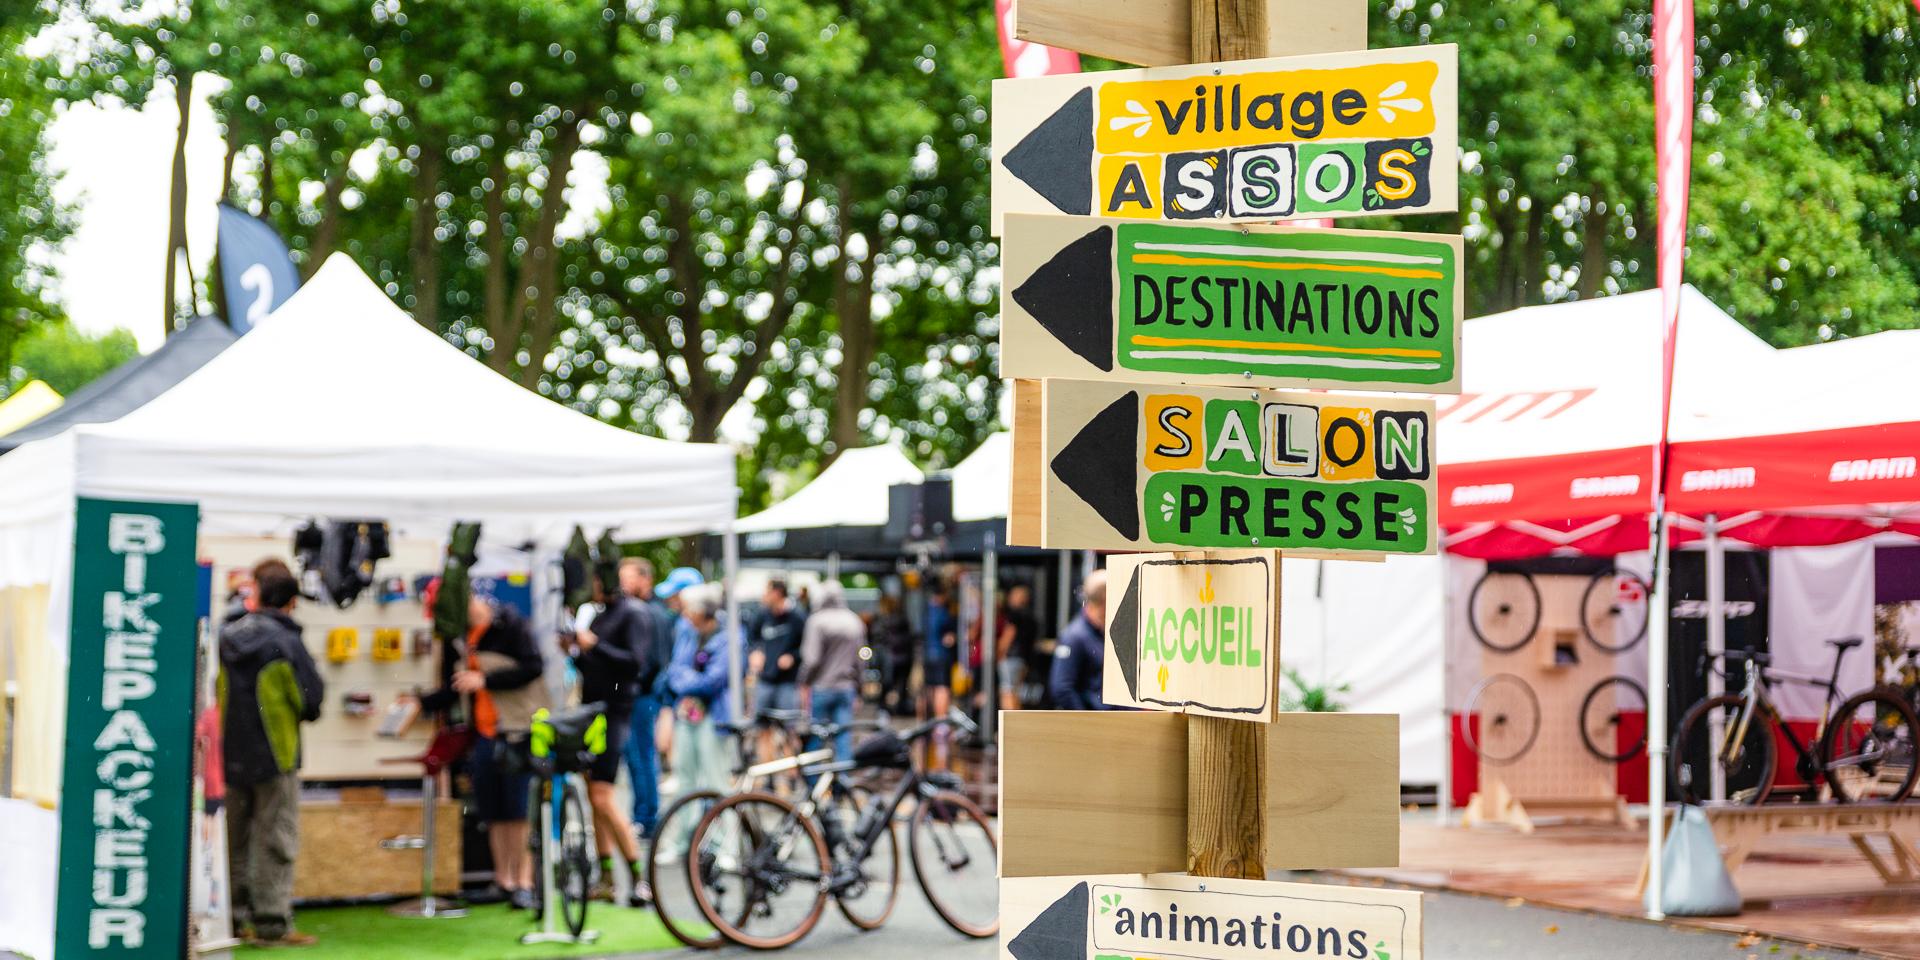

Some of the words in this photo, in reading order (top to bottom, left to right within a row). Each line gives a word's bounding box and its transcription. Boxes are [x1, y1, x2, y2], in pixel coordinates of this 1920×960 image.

[1155, 84, 1368, 138] village
[1108, 148, 1417, 212] ASSOS
[1133, 274, 1440, 338] DESTINATIONS
[1154, 405, 1423, 474] SALON
[1829, 456, 1916, 482] SRAM
[1179, 484, 1400, 541] PRESSE
[1142, 605, 1262, 668] ACCUEIL
[88, 512, 165, 949] BIKEPACKEUR
[1114, 903, 1370, 960] animations
